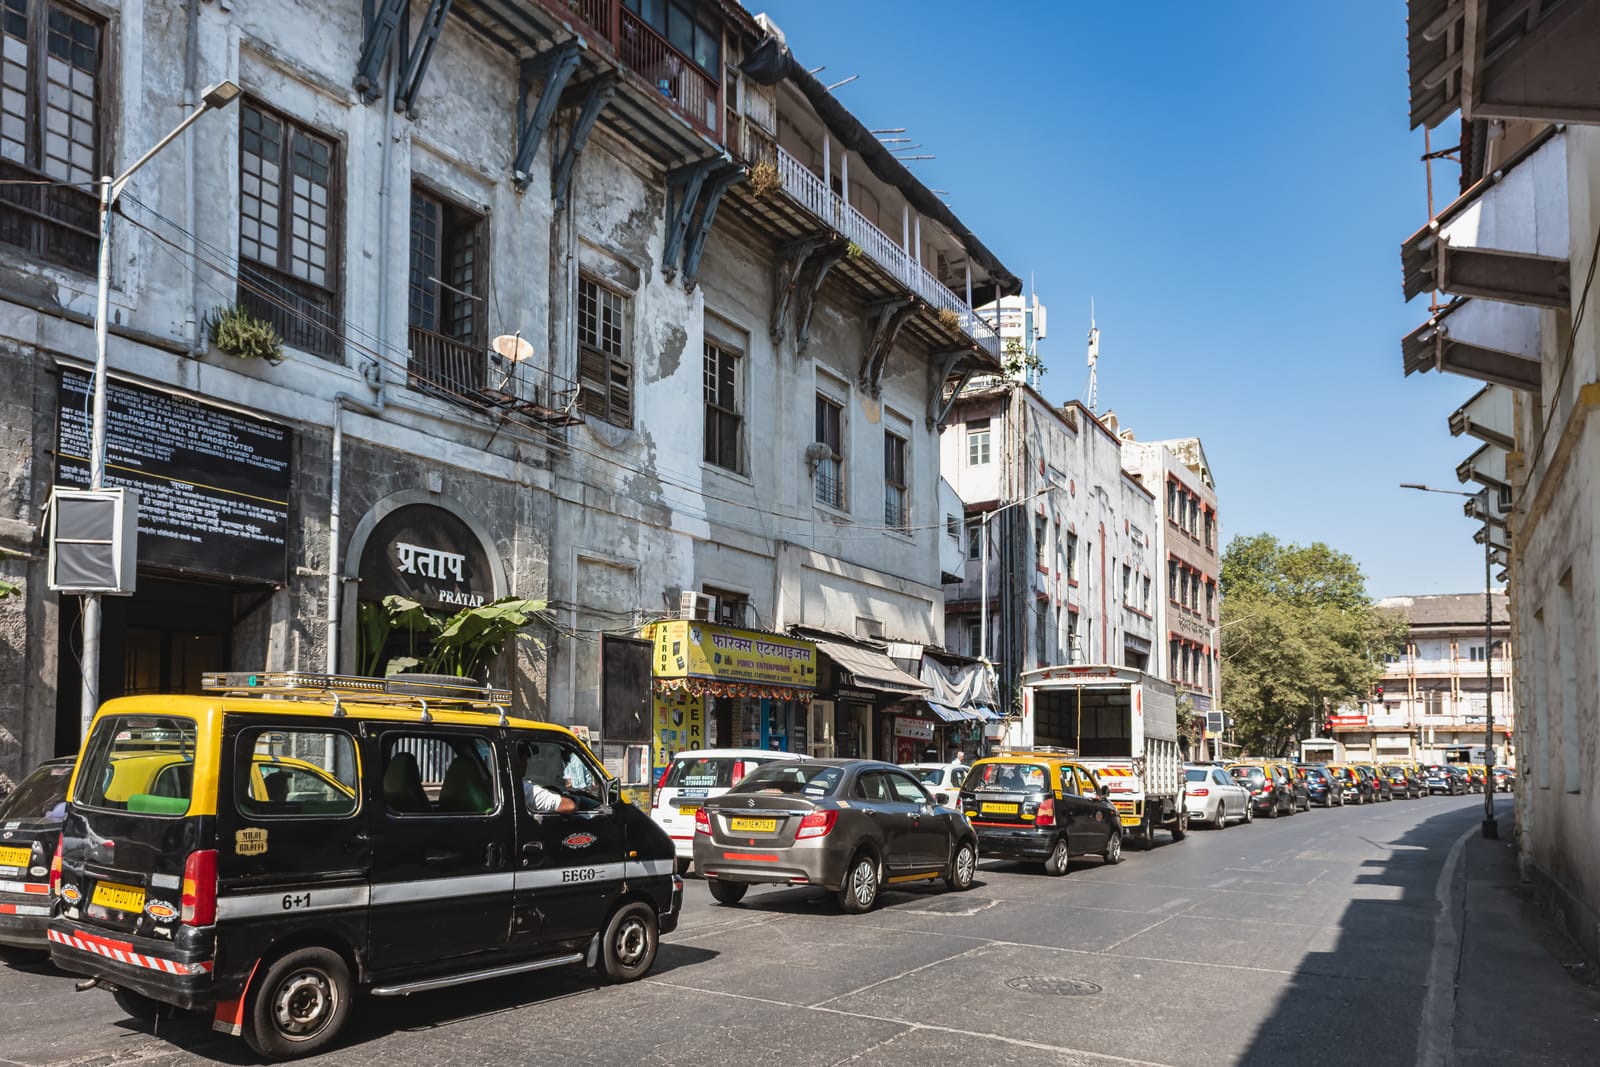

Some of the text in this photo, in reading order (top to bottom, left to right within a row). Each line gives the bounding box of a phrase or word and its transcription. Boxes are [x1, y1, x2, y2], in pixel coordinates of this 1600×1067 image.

[108, 383, 137, 396] EDUCATION
[139, 392, 157, 401] TRUST
[172, 394, 199, 407] NOTICE
[107, 409, 166, 431] TRESPASSERS
[169, 425, 185, 436] WILL
[188, 430, 198, 439] BE
[201, 433, 253, 453] PROSECUTED
[128, 407, 145, 418] THIS
[163, 417, 195, 431] PRIVATE
[198, 425, 238, 442] PROPERTY
[62, 406, 73, 414] ANY
[263, 457, 287, 468] WITHOUT
[107, 442, 132, 453] WESTERN
[396, 542, 465, 582] प्रताप
[438, 589, 484, 607] PRATAP
[282, 892, 312, 910] 6+1
